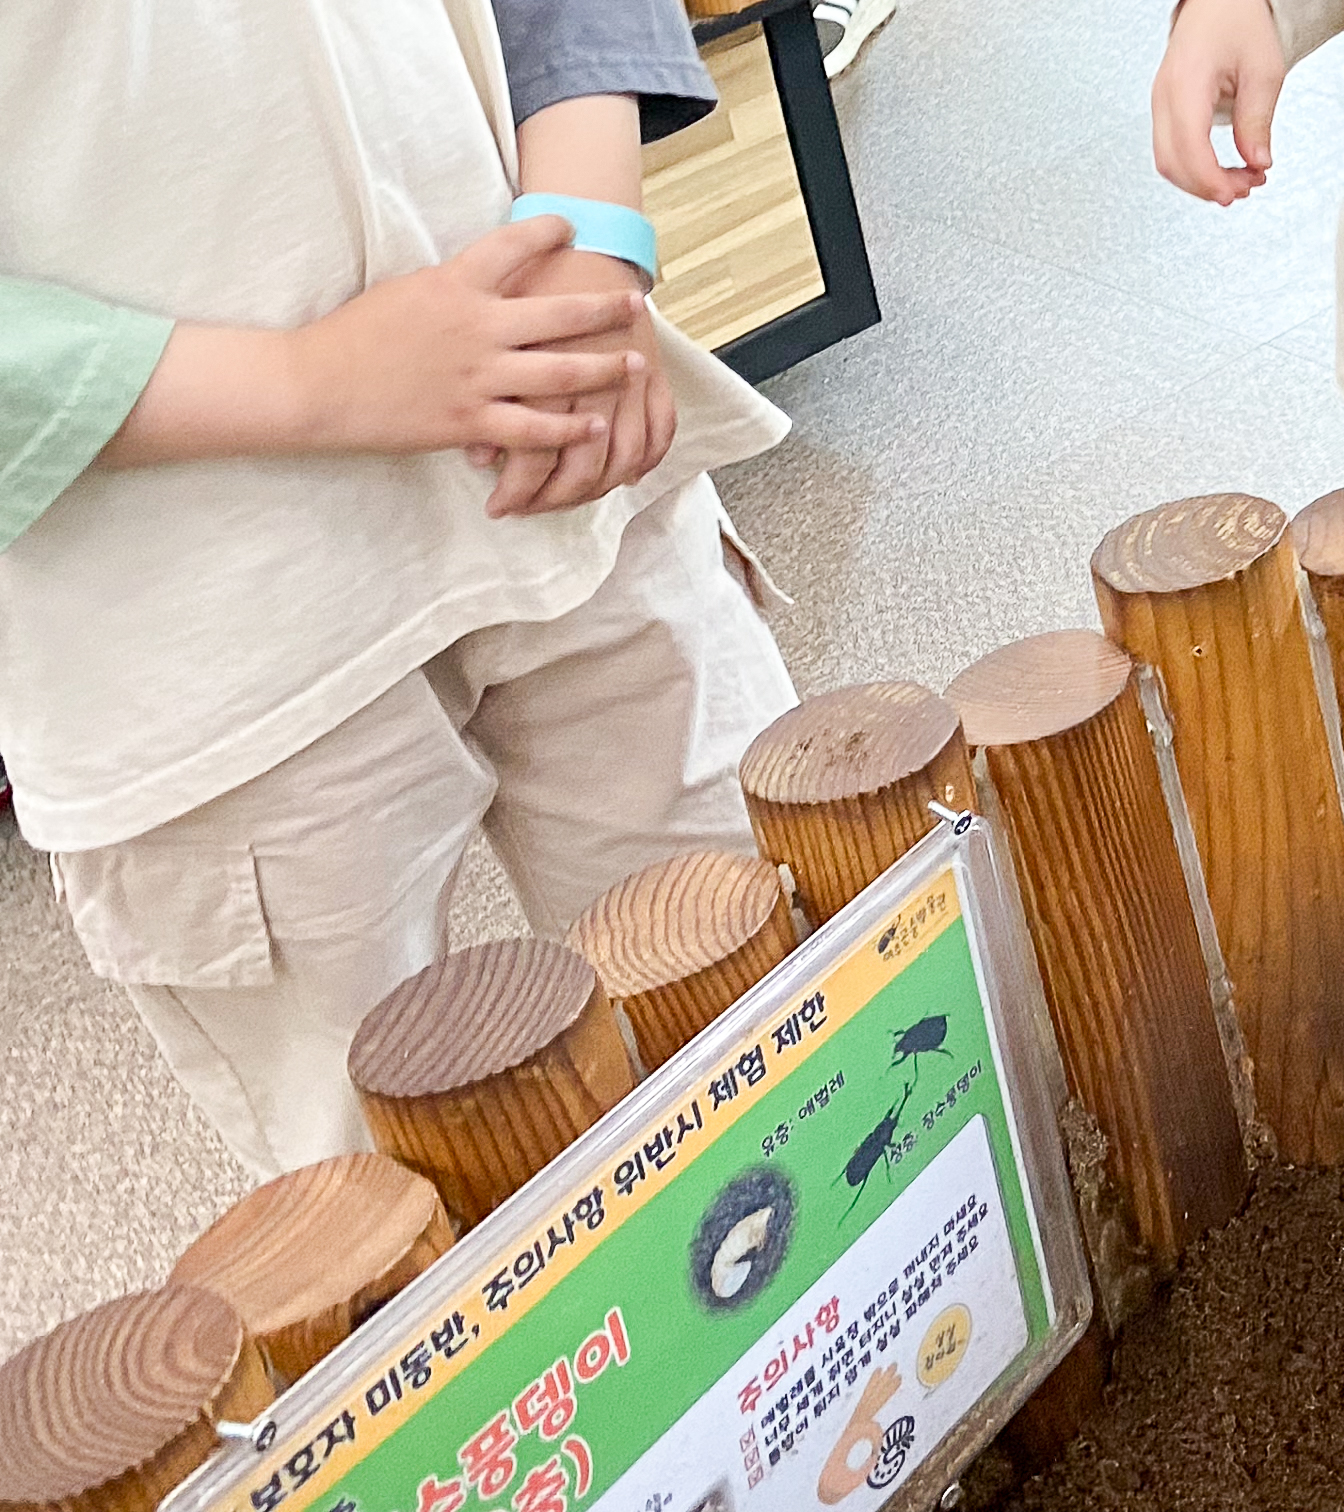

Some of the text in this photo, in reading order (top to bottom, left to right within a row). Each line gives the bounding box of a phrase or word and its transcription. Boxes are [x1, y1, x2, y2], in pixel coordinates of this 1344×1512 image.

[761, 1070, 845, 1158] 유충: 애벌레
[921, 1059, 982, 1130] 장수풍뎅이
[250, 991, 829, 1512] 보호자 미동반, 주의사항 위반시 체험 제한
[943, 1193, 977, 1236] 마세요
[946, 1235, 979, 1276] 주세요
[859, 1302, 897, 1349] 터지니
[956, 1202, 989, 1243] 주세요
[737, 1294, 840, 1414] 주의사항
